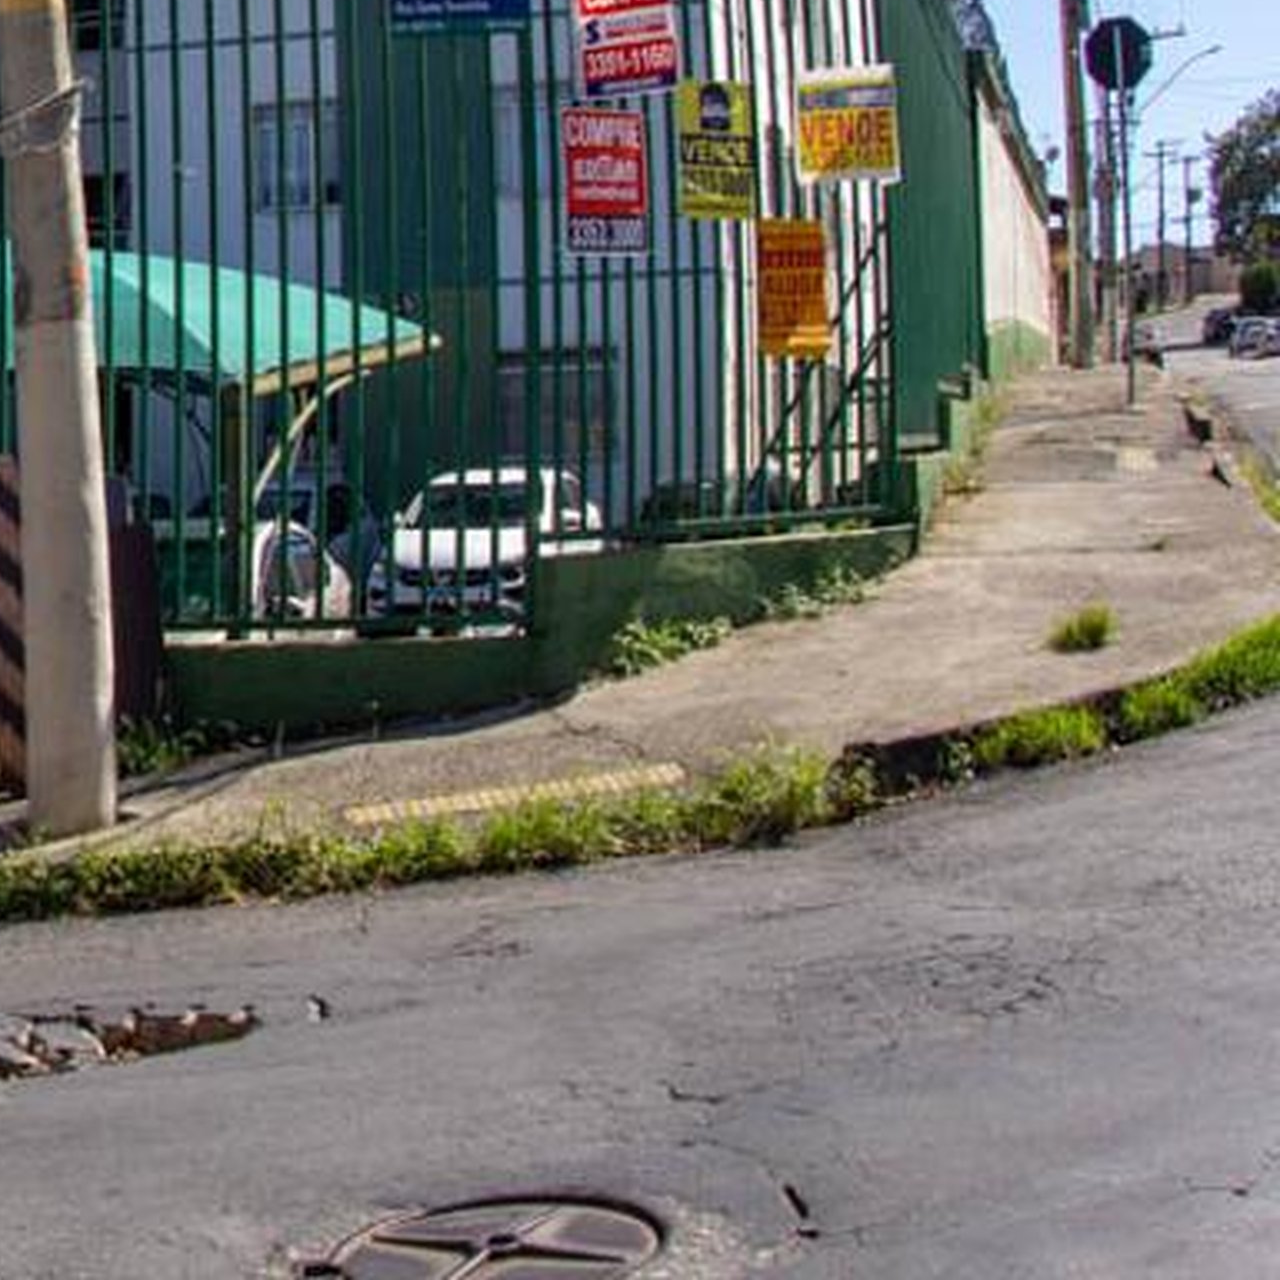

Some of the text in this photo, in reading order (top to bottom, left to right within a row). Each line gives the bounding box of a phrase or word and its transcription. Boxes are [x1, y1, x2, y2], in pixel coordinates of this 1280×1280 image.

[565, 115, 640, 148] COMPRE
[800, 109, 892, 147] VENDE
[682, 140, 749, 163] VENDE
